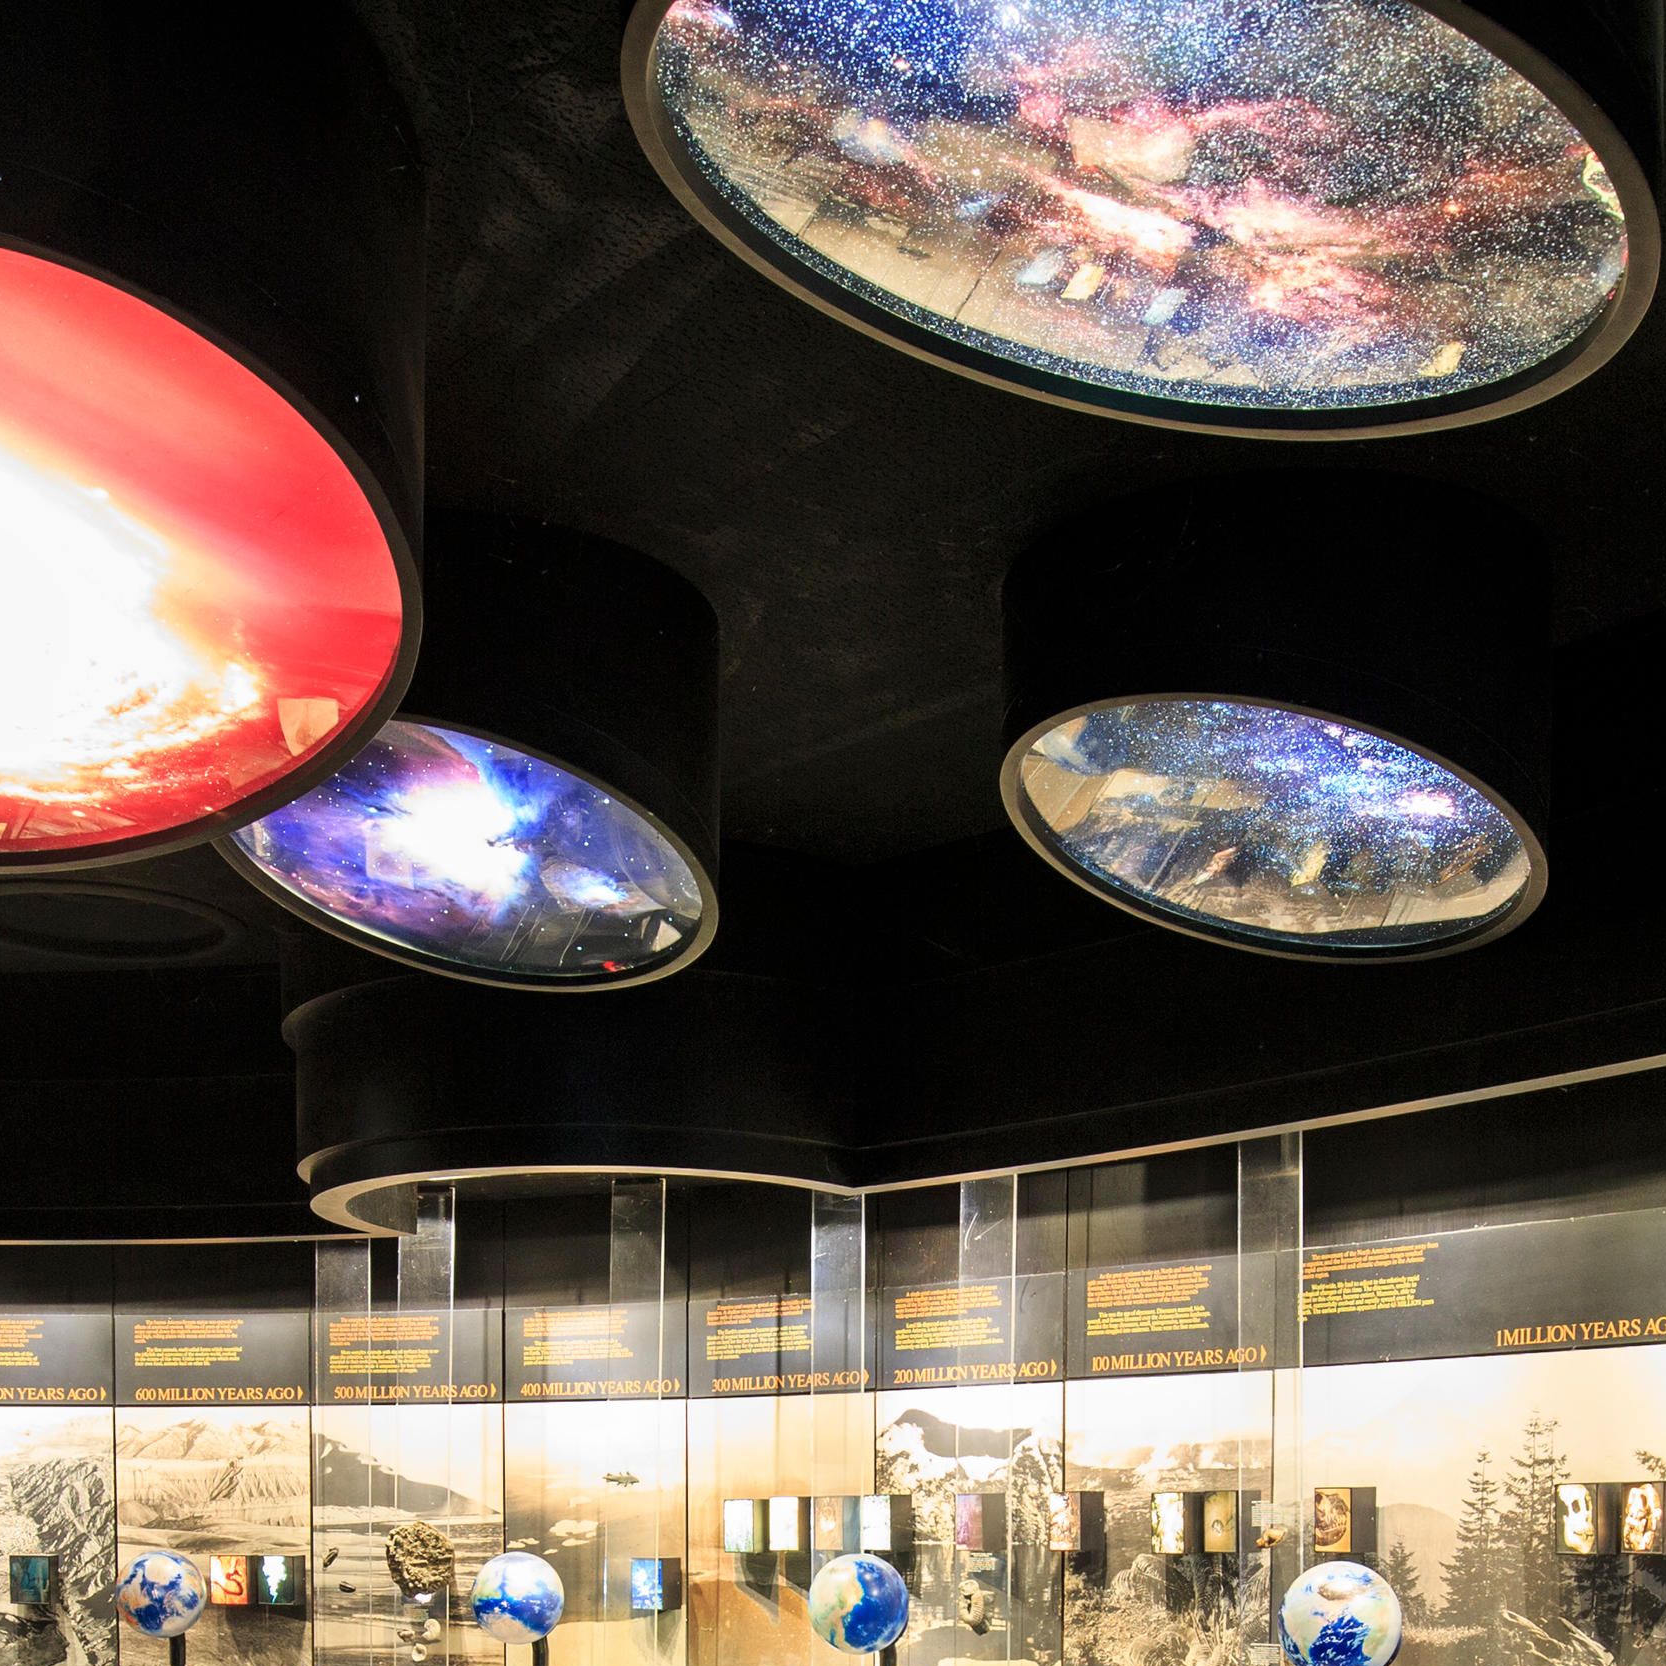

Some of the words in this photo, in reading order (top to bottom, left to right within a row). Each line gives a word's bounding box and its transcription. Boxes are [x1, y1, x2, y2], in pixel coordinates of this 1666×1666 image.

[1503, 1324, 1576, 1345] MILLION
[1579, 1318, 1642, 1340] YEARS
[1092, 1356, 1109, 1371] 100
[1111, 1352, 1171, 1370] MILLION
[1173, 1349, 1223, 1367] YEARS
[1225, 1347, 1258, 1364] AGO
[712, 1378, 731, 1392] 300
[732, 1375, 784, 1391] MILLION
[787, 1372, 830, 1388] YEARS
[831, 1370, 860, 1386] AGO
[893, 1369, 913, 1384] 200
[914, 1367, 968, 1383] MILLION
[971, 1363, 1016, 1380] YEARS
[1017, 1361, 1049, 1377] AGO
[17, 1387, 65, 1401] YEARS
[67, 1388, 98, 1401] AGO
[135, 1388, 156, 1401] 600
[158, 1387, 213, 1401] MILLION
[213, 1388, 263, 1401] YEARS
[265, 1387, 294, 1400] AGO
[334, 1386, 354, 1399] 500
[355, 1385, 410, 1399] MILLION
[413, 1385, 458, 1399] YEARS
[459, 1384, 488, 1398] AGO
[520, 1383, 541, 1397] 400
[542, 1382, 598, 1396] MILLION
[598, 1381, 643, 1395] YEARS
[644, 1380, 672, 1393] AGO
